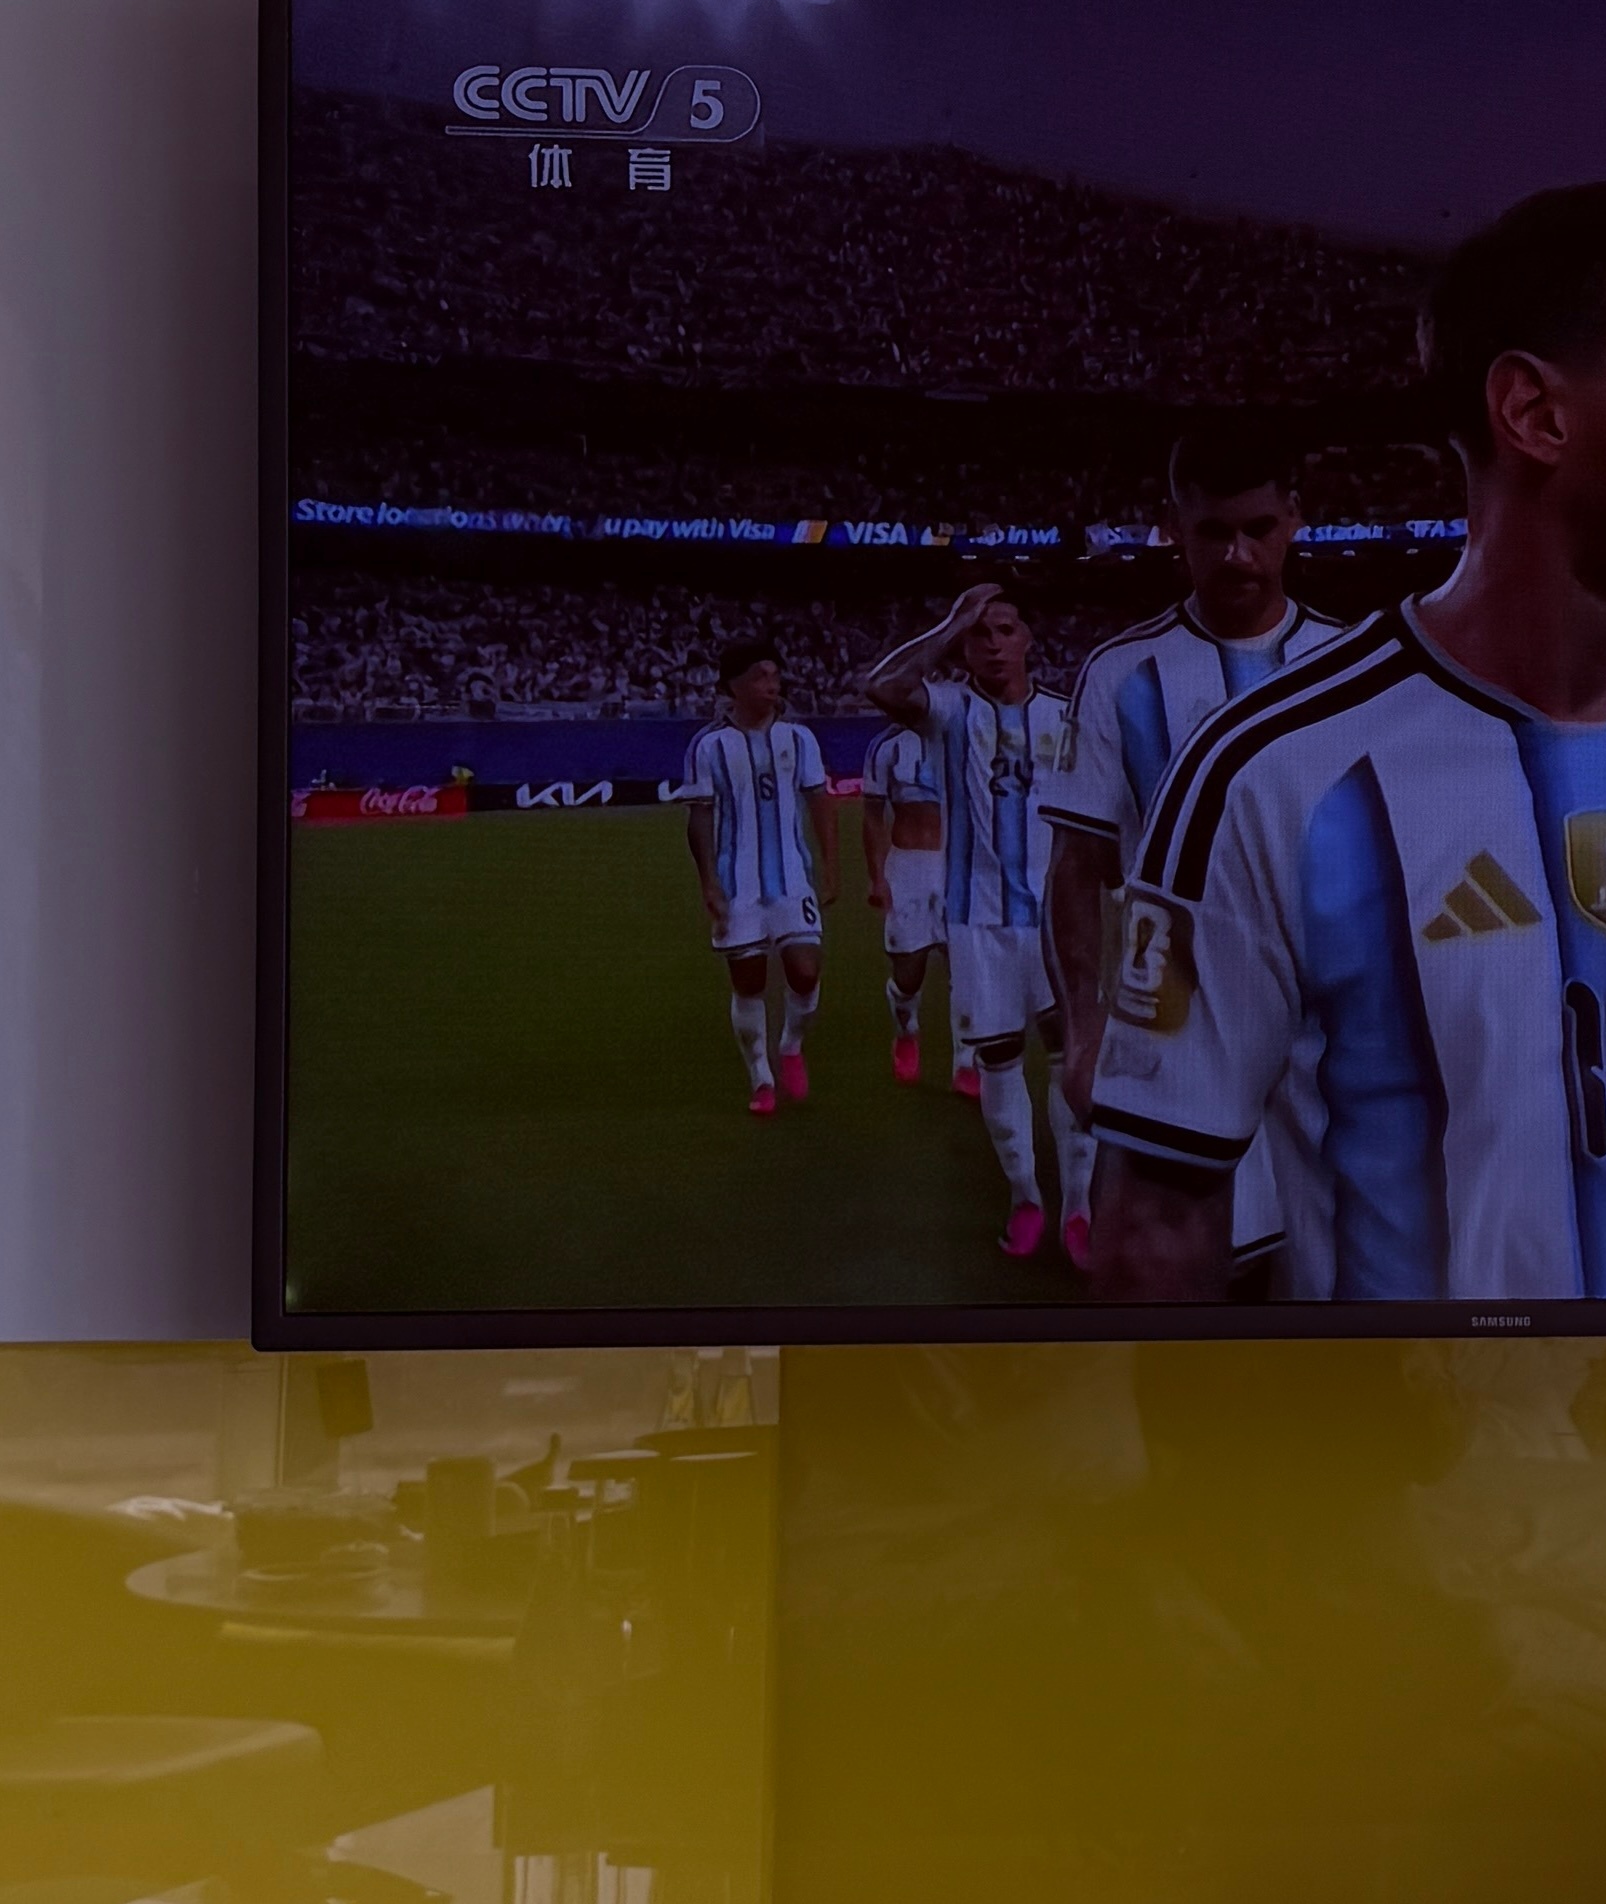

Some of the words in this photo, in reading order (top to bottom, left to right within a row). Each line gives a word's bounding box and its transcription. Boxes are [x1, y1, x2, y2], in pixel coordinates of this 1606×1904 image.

[453, 65, 651, 124] CCTV
[690, 79, 725, 129] 5
[528, 143, 672, 193] 体育
[296, 498, 374, 524] Store
[729, 517, 775, 540] Visa
[843, 521, 909, 545] VISA
[1470, 1316, 1532, 1328] SAMSUNG
